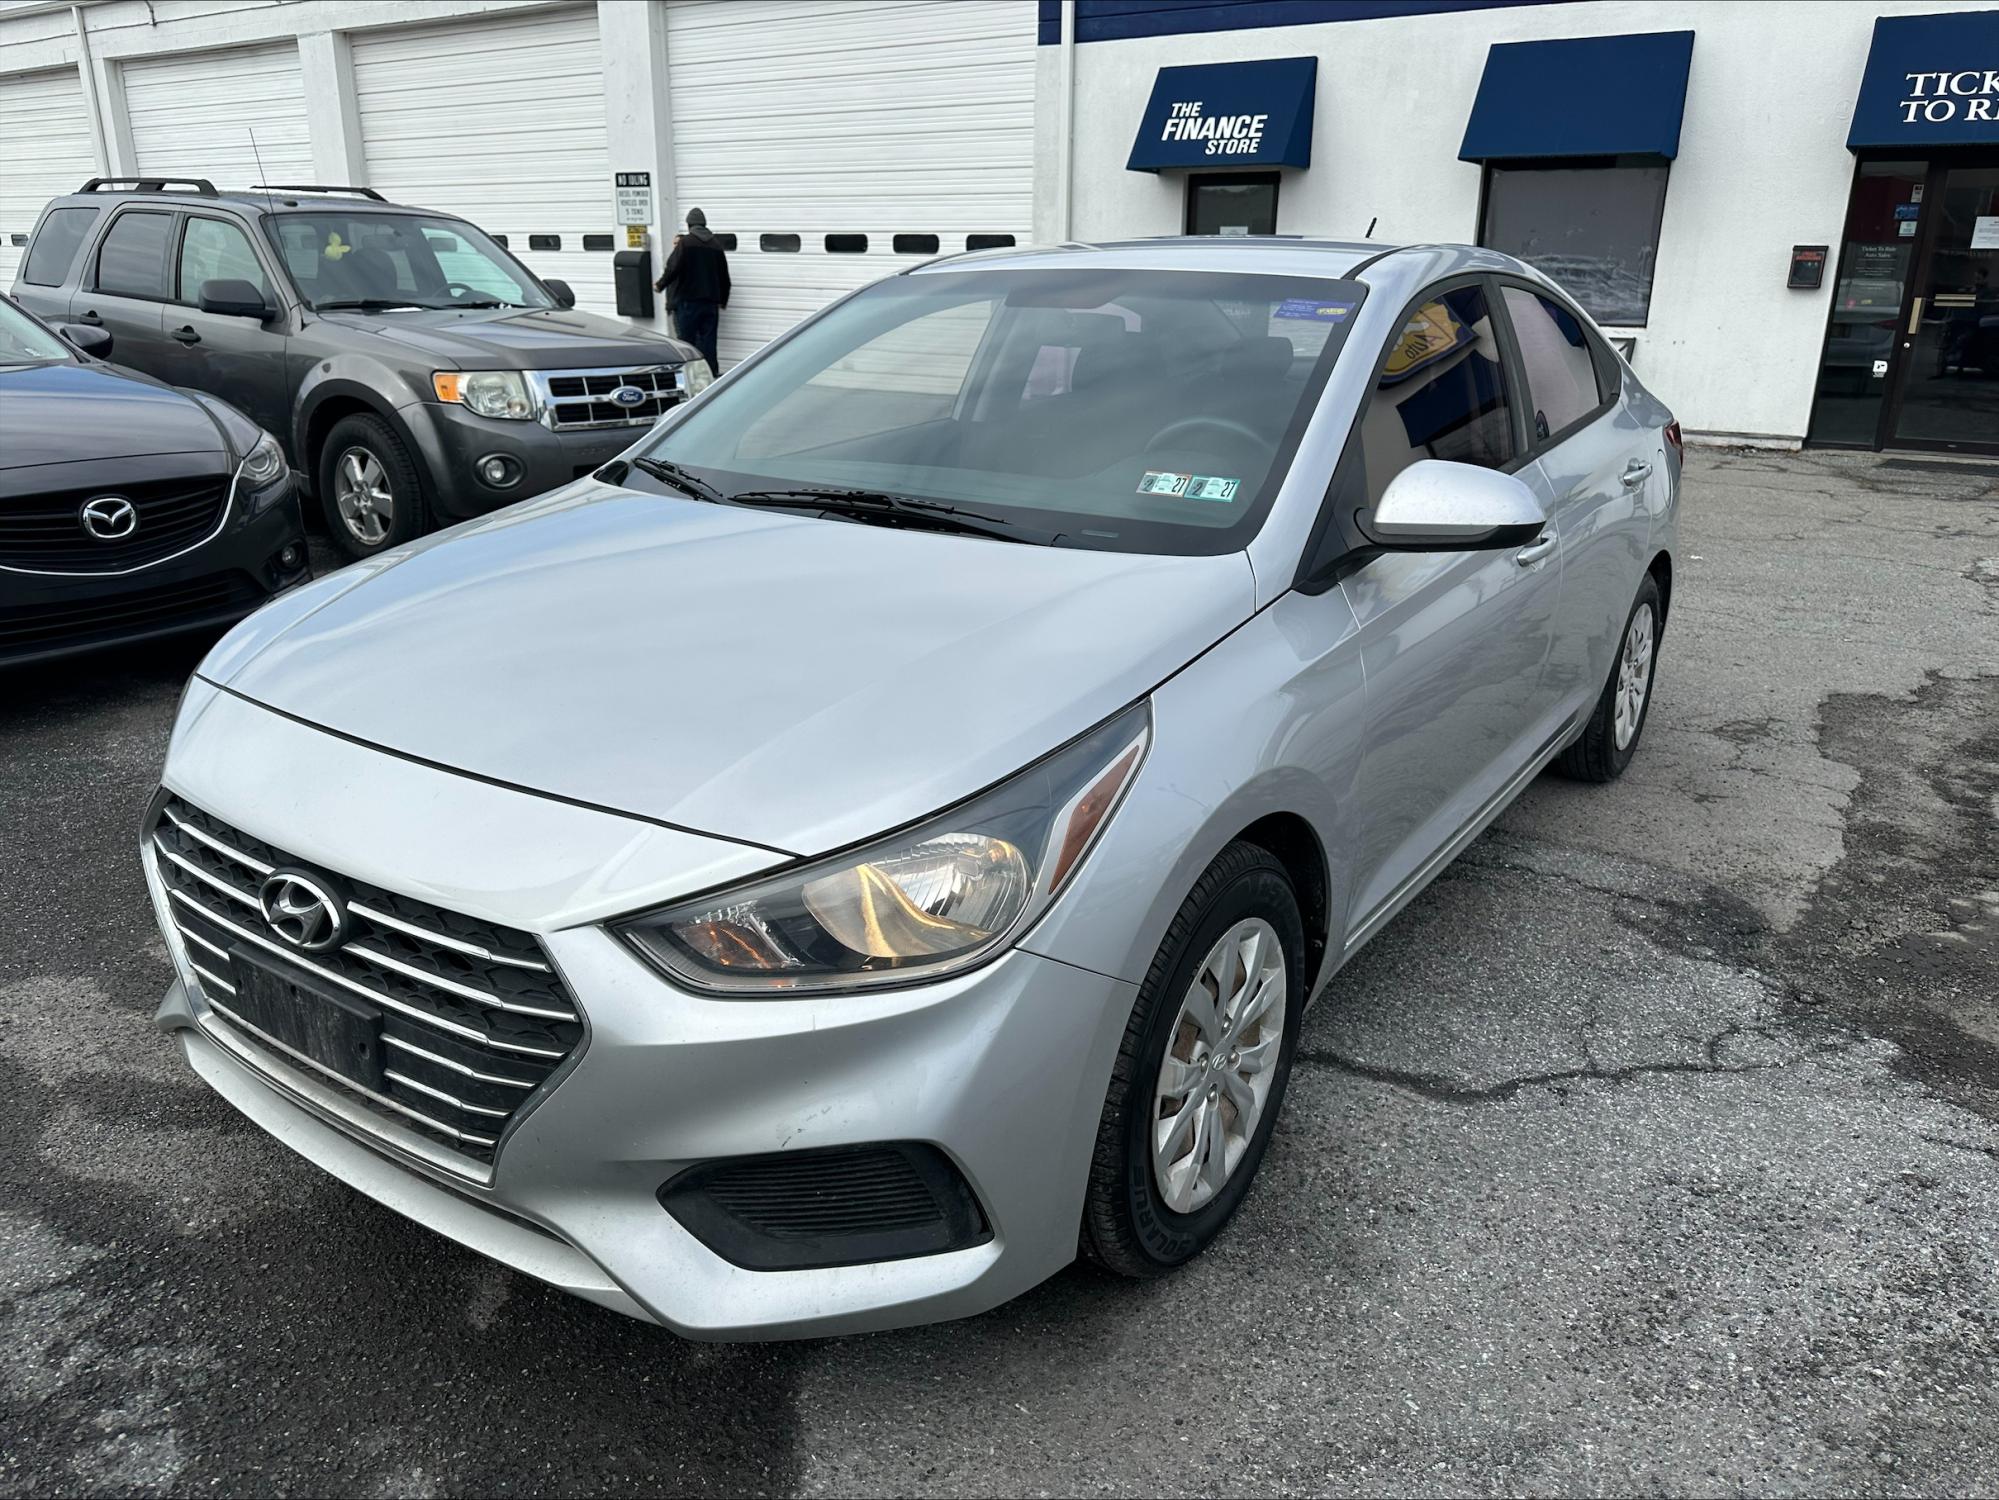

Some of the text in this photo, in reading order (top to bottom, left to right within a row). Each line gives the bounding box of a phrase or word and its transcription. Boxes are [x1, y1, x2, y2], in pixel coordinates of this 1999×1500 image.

[1905, 70, 1999, 96] TICK
[1171, 101, 1203, 118] THE
[1900, 100, 1956, 122] TO
[1161, 114, 1268, 141] FINANCE
[1205, 138, 1261, 155] STORE
[618, 174, 627, 186] NO
[1171, 477, 1187, 493] 27
[1220, 481, 1236, 498] 27
